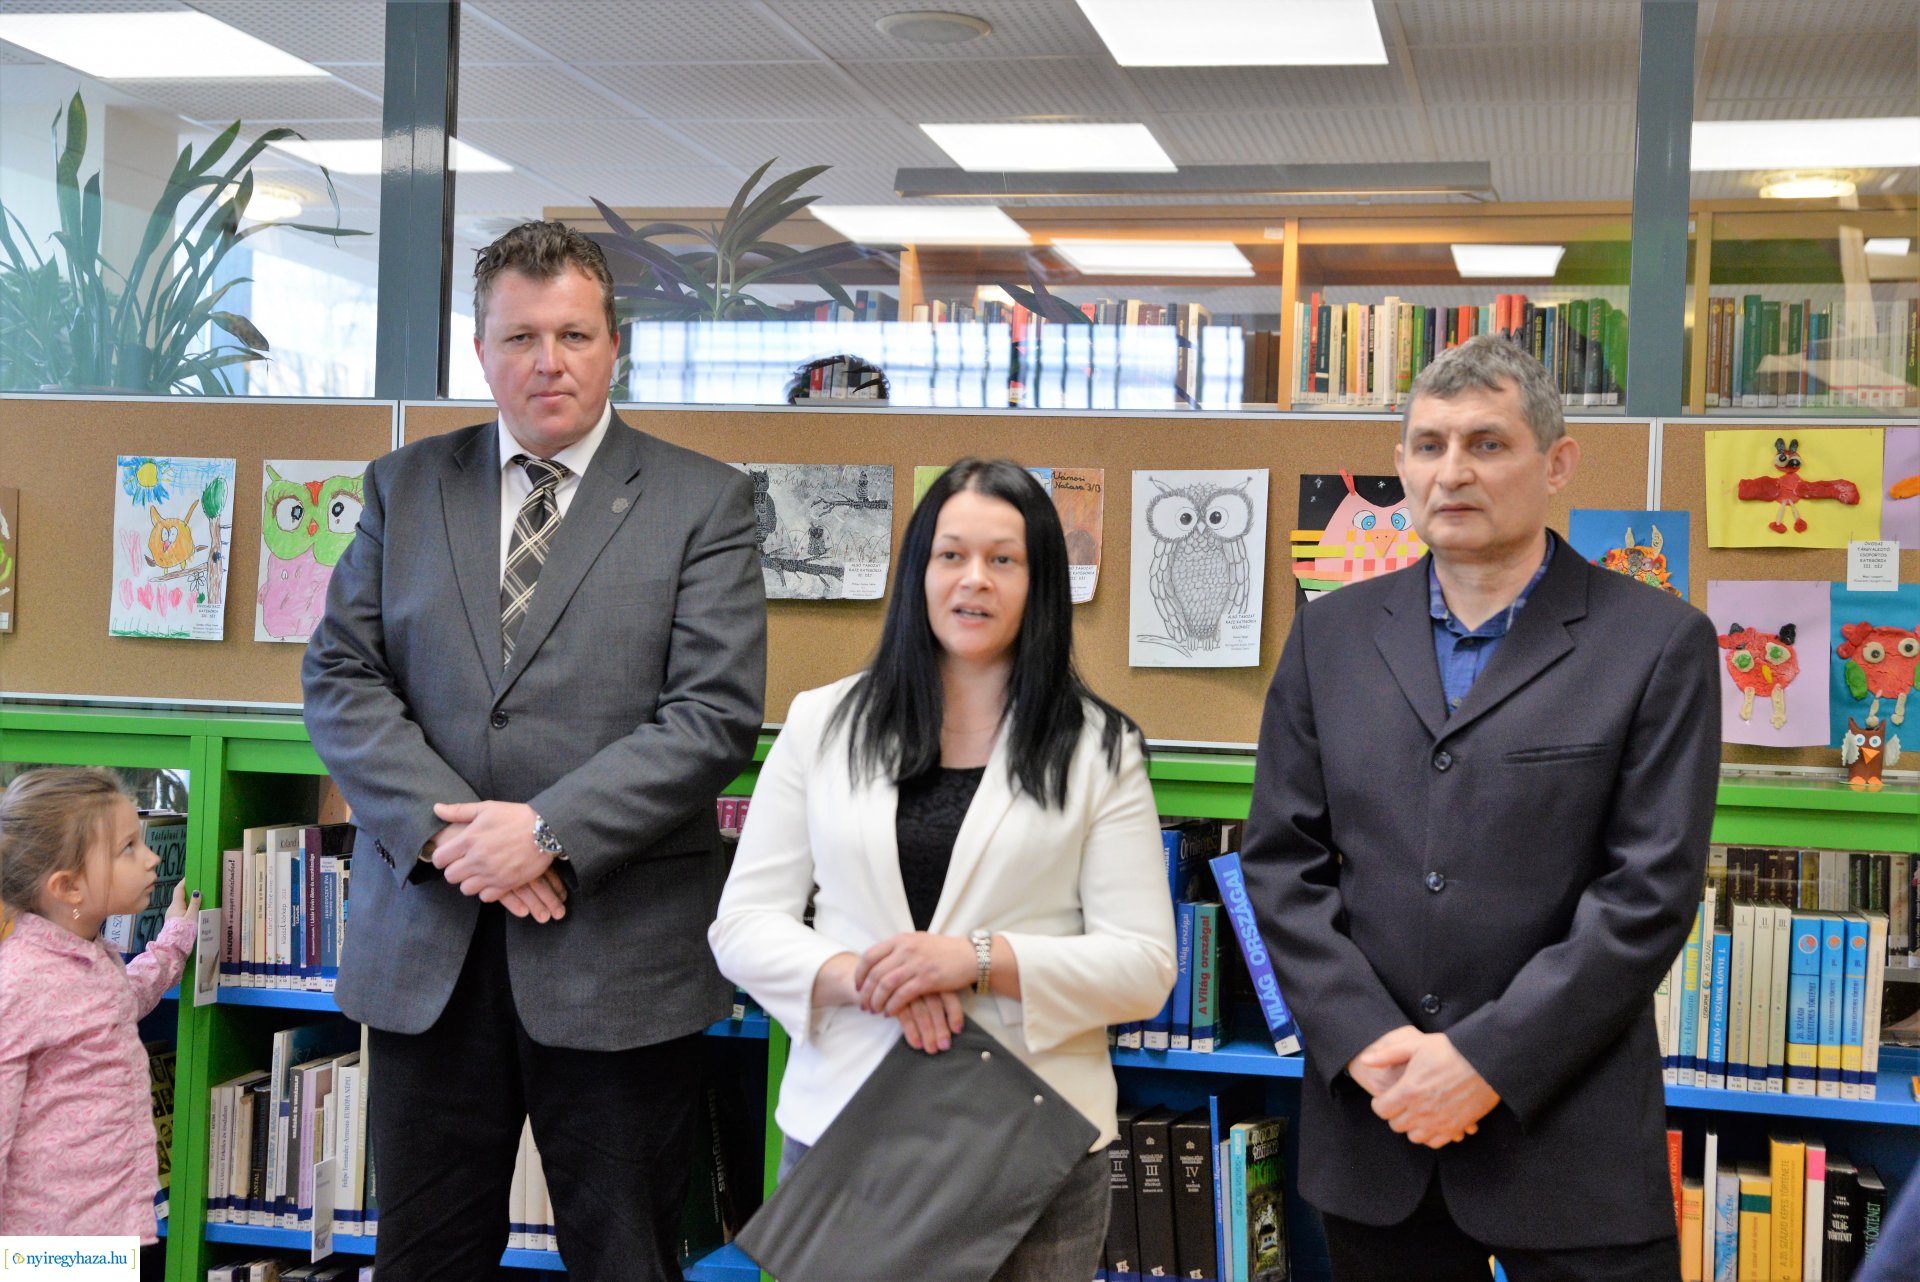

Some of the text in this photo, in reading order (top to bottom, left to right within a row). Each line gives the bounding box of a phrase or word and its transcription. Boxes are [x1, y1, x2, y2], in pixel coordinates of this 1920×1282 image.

[1180, 945, 1189, 967] Világ
[1223, 868, 1289, 1030] VILÁG ORSZÁGAI
[1199, 915, 1211, 1015] A Világ országai
[1715, 957, 1725, 985] KÖNYVE
[1713, 987, 1724, 1022] ÉVSZÁMOK
[1712, 1028, 1722, 1045] JENŐ
[1807, 1010, 1816, 1041] EGYETEMES
[1112, 1160, 1123, 1171] II
[1145, 1165, 1158, 1176] III
[1185, 1166, 1199, 1177] IV
[1779, 1160, 1790, 1197] TÖRTÉNETE
[341, 1173, 349, 1188] Felipe
[1779, 1199, 1789, 1220] KÉPES
[1863, 1202, 1881, 1241] TÖRTÉNET
[1780, 1222, 1789, 1249] SZÁZAD
